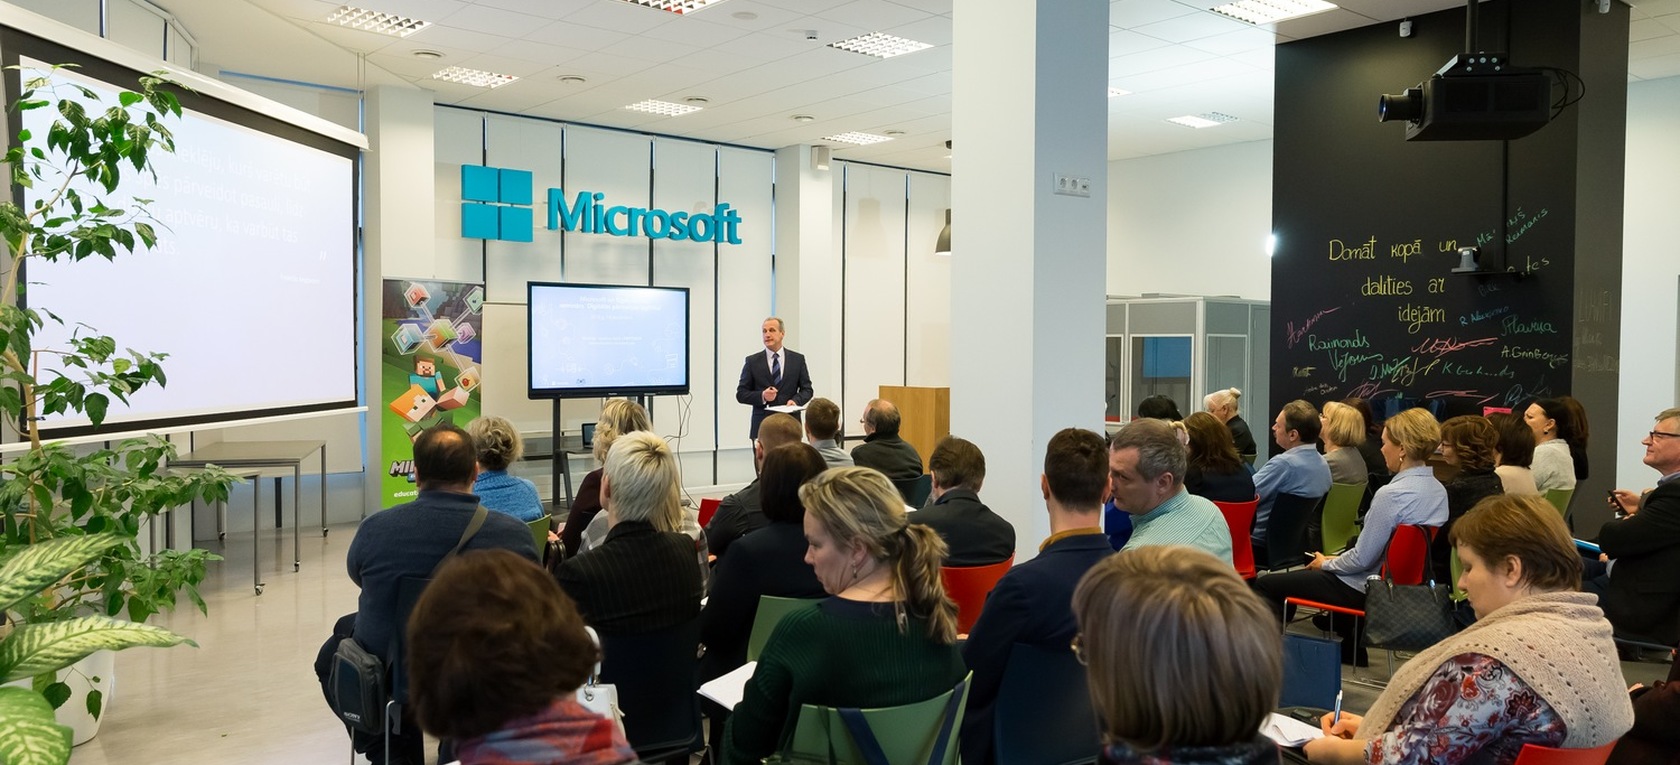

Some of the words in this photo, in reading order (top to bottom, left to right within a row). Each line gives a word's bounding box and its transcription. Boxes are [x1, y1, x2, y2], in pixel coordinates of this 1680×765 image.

[547, 187, 742, 245] Microsoft
[1328, 235, 1378, 261] Domāt
[1390, 239, 1423, 264] kopā
[1438, 239, 1457, 253] un
[1427, 277, 1445, 293] ar
[1398, 303, 1445, 334] idejām
[343, 711, 361, 720] SONY
